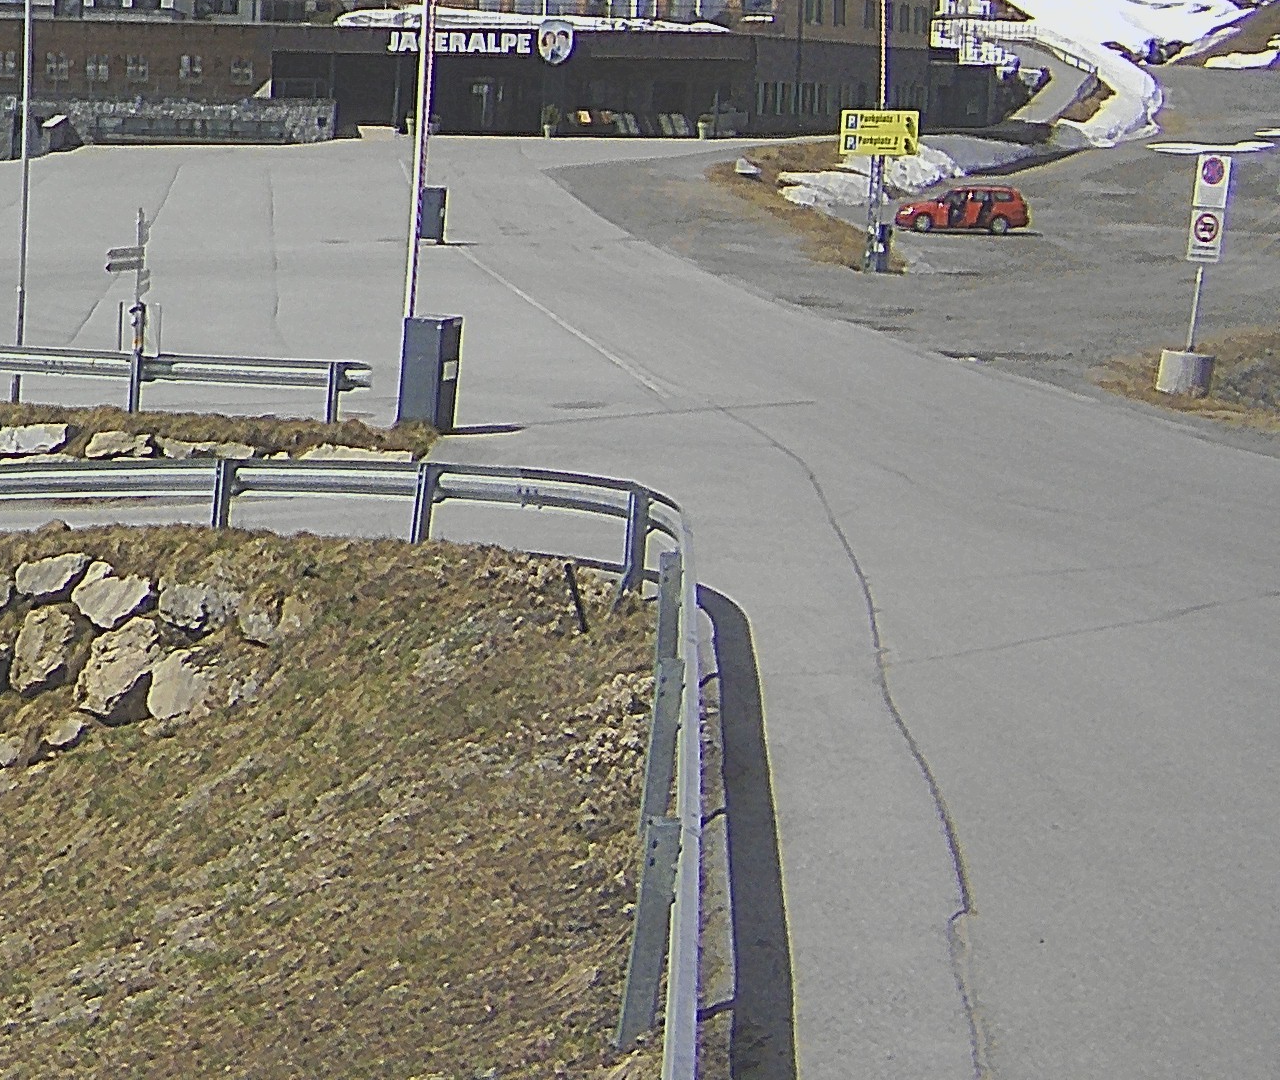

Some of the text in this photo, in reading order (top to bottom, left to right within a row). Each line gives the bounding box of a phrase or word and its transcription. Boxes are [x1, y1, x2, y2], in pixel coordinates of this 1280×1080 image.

[387, 31, 531, 53] JAERALPE
[860, 114, 893, 124] Parkplatz
[858, 136, 891, 146] Parkplatz
